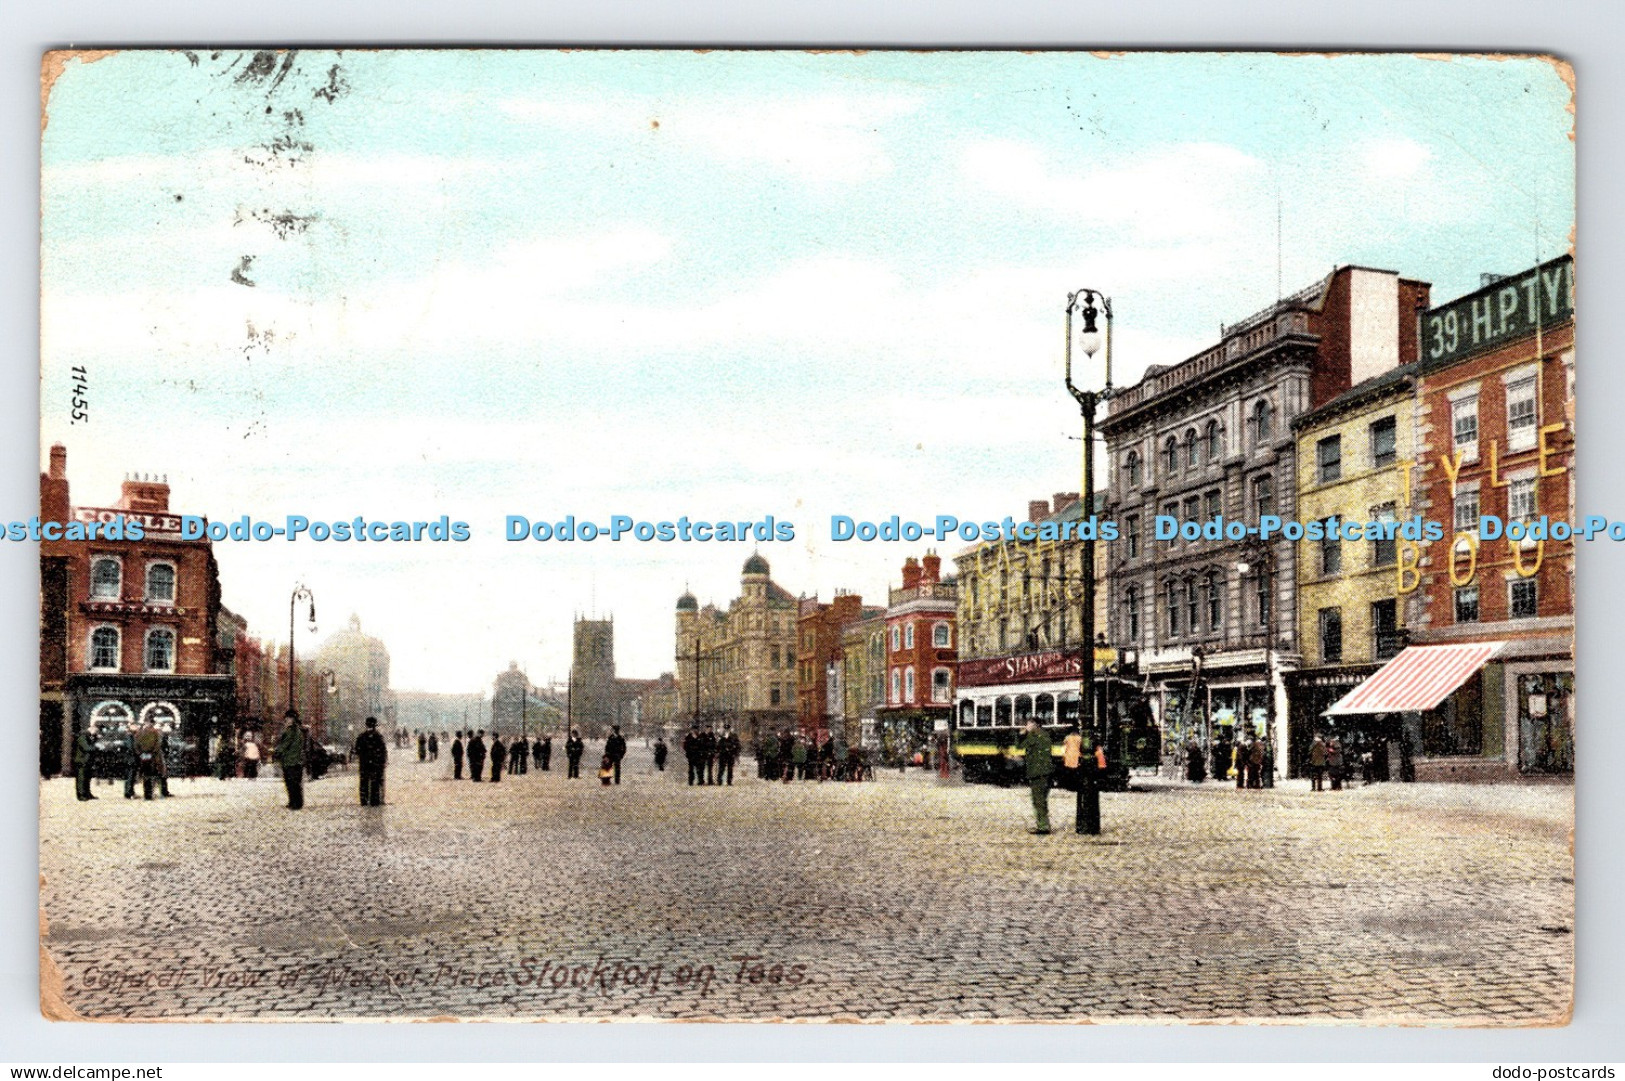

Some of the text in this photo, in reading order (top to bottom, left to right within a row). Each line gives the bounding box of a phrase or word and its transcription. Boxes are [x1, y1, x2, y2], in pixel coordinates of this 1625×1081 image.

[1430, 310, 1459, 359] 39
[70, 365, 88, 424] 11455.
[1397, 422, 1567, 507] TYLE
[76, 509, 200, 533] COWLE
[514, 956, 663, 995] Stockton
[676, 963, 716, 996] on
